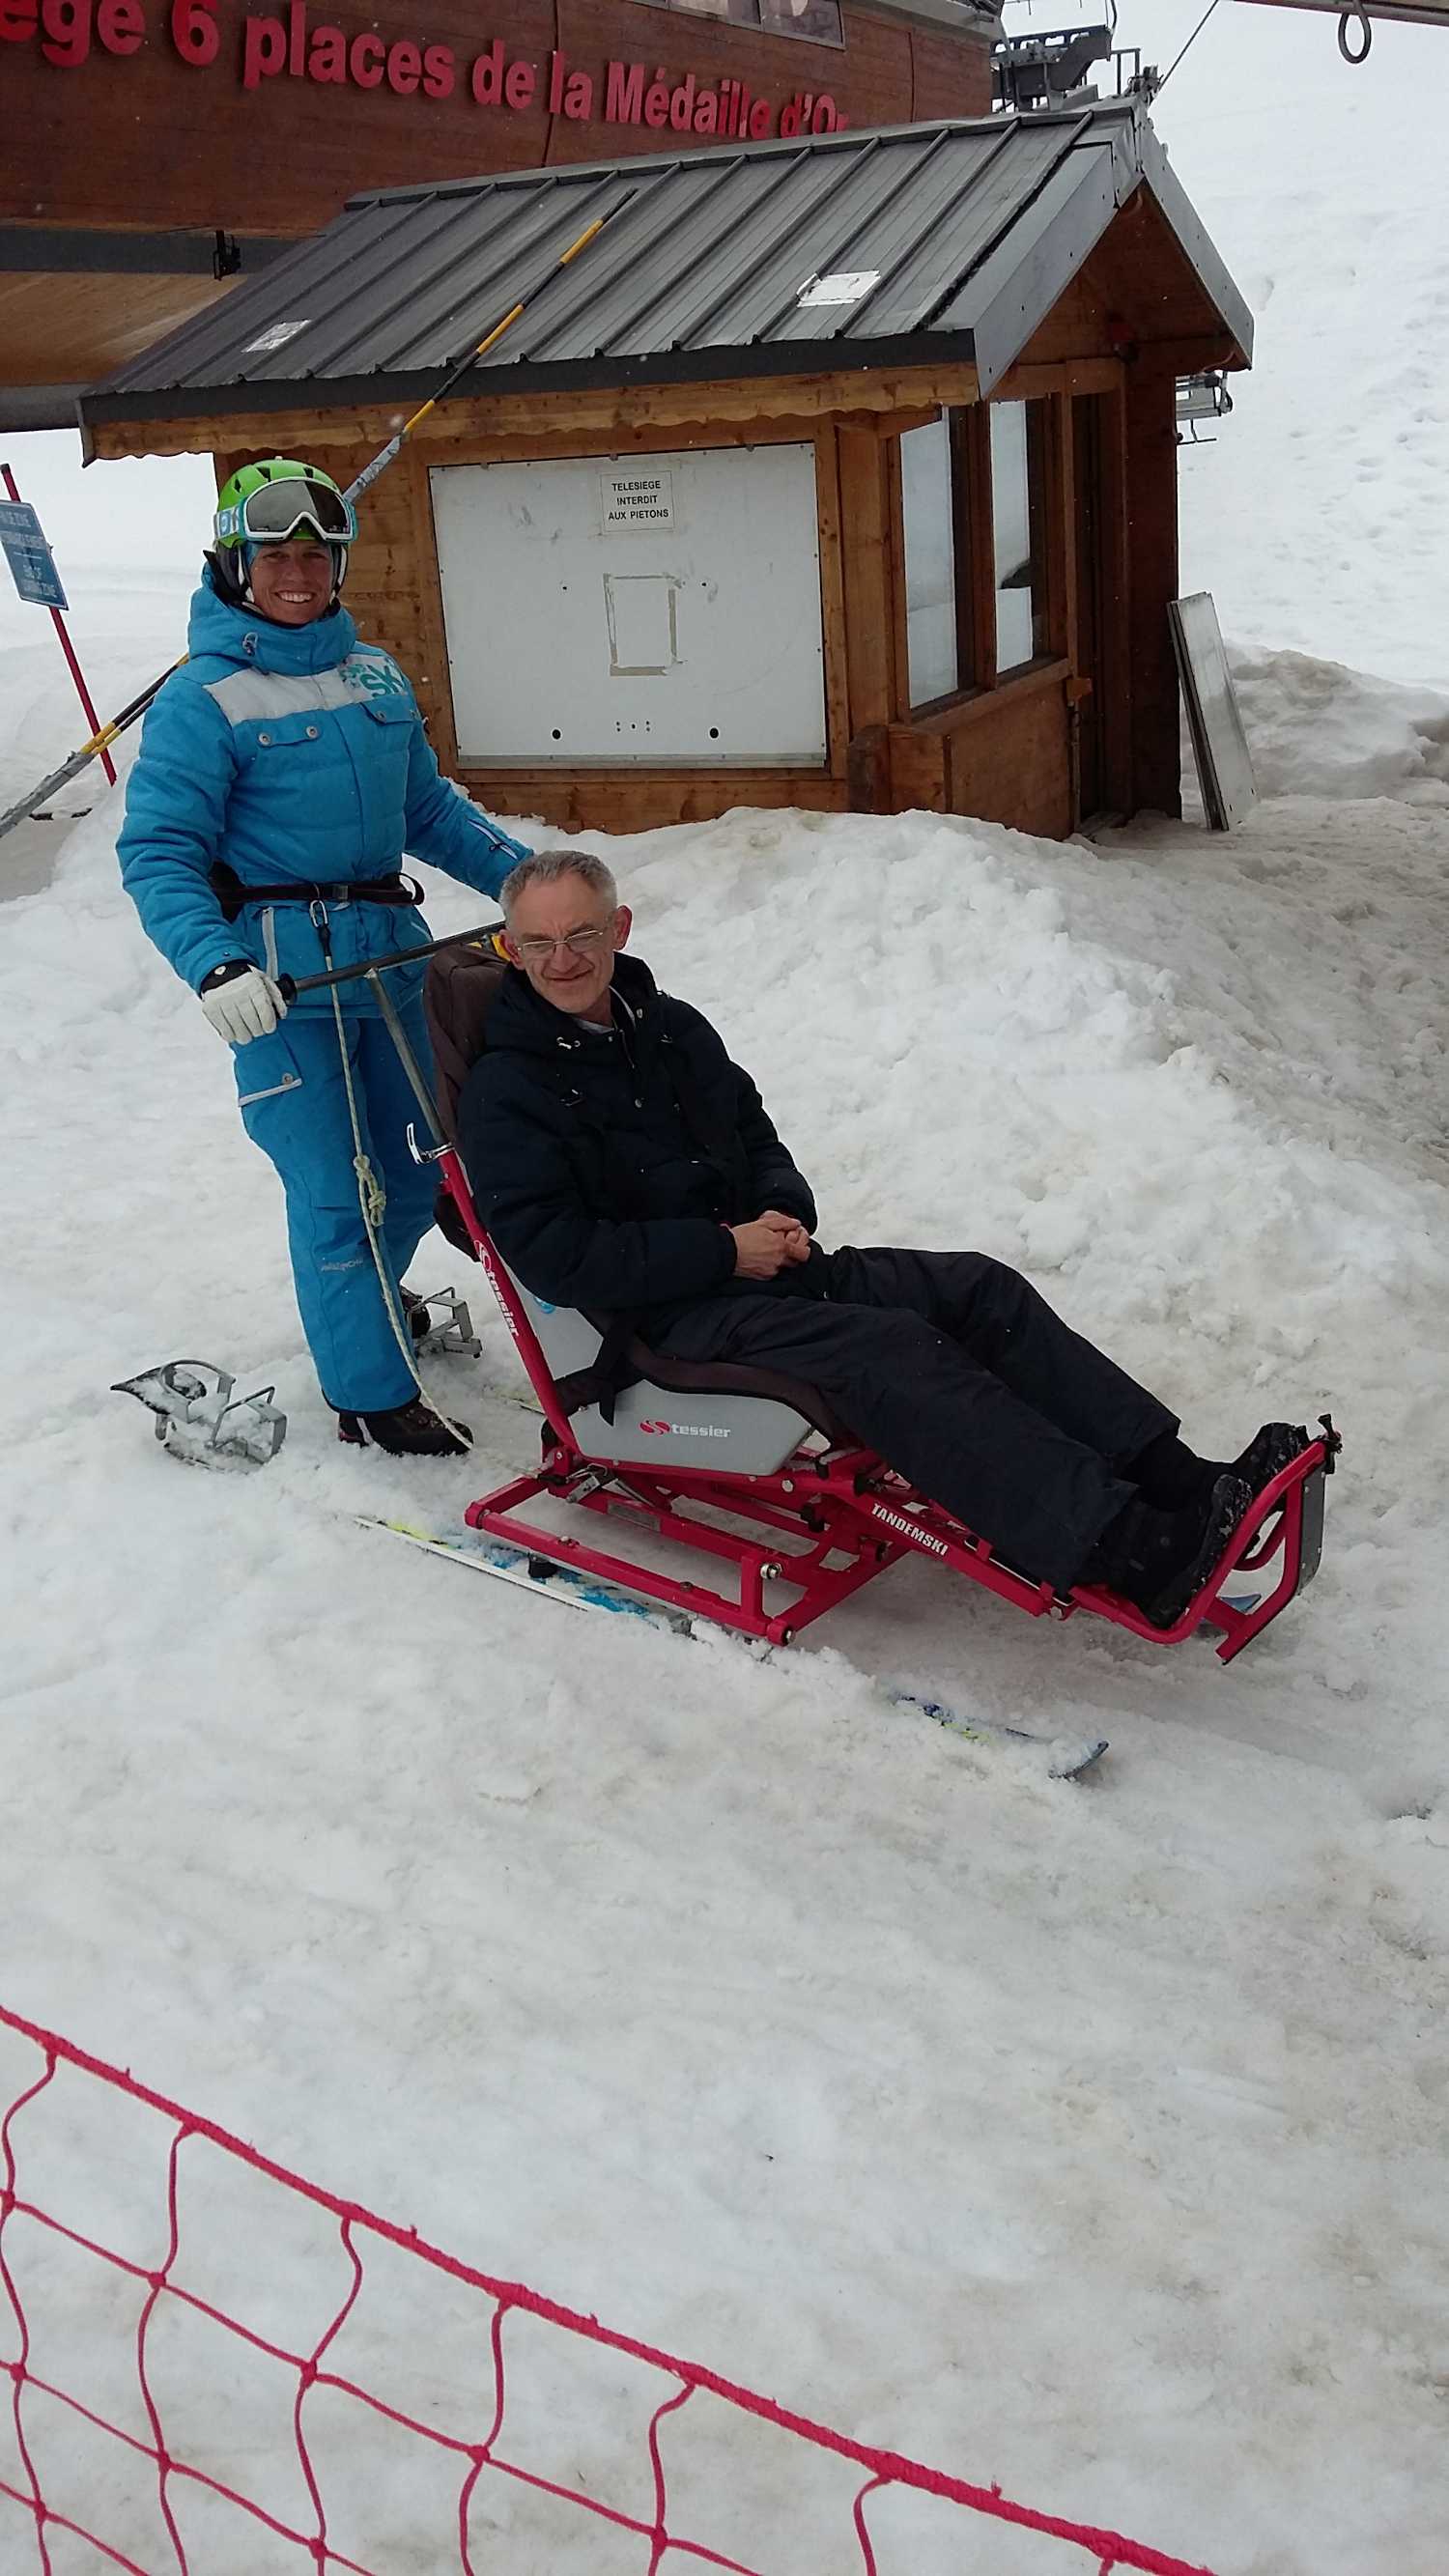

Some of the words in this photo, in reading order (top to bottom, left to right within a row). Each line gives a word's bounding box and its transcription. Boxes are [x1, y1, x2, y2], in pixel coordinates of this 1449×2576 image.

[172, 0, 220, 66] 6
[243, 0, 455, 98] places
[472, 39, 535, 109] de
[550, 51, 593, 120] la
[605, 61, 771, 139] Médaille
[611, 481, 661, 492] TELESIEGE
[616, 495, 658, 506] INTERDIT
[608, 511, 627, 521] AUX
[630, 509, 669, 520] PIETONS
[671, 1424, 731, 1438] tessier
[871, 1503, 949, 1556] TANDEMSKI
